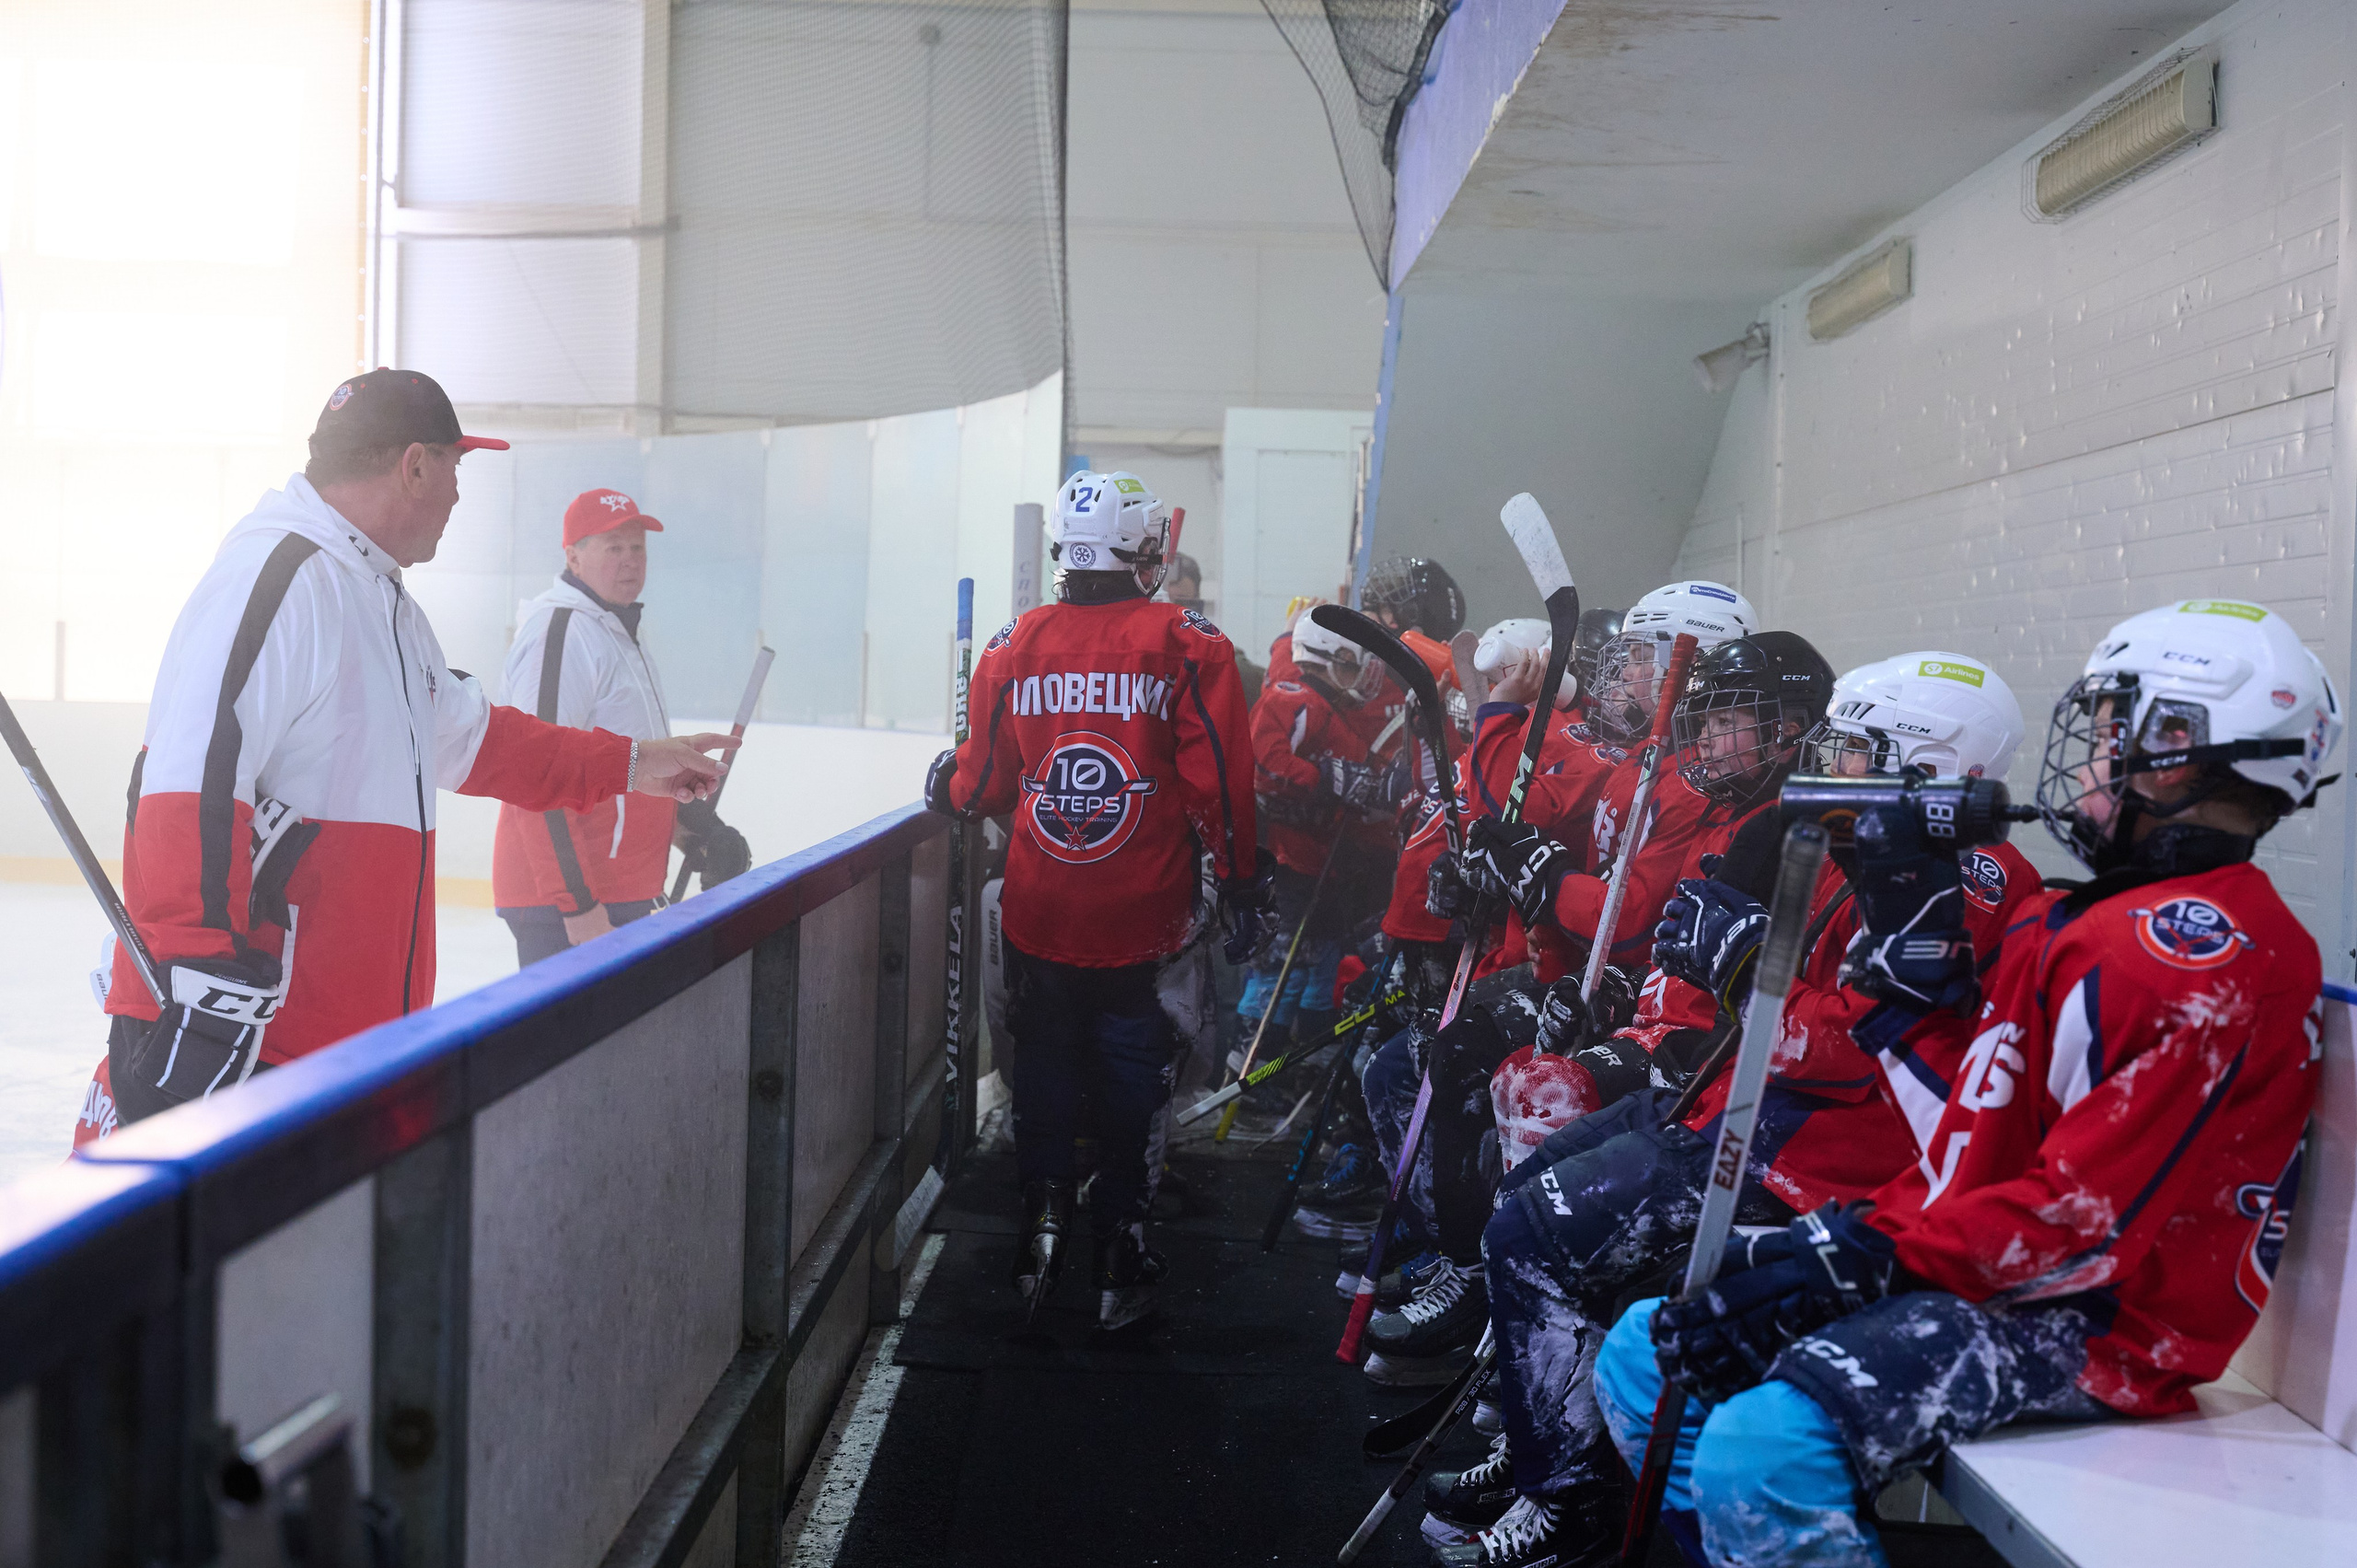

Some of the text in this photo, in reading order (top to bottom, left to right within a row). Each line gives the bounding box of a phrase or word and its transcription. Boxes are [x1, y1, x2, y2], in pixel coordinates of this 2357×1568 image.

[1075, 487, 1093, 512] 2
[1686, 619, 1725, 633] BAUER
[2163, 651, 2211, 666] CCM
[1945, 667, 1980, 681] Airlines
[1014, 672, 1177, 722] ЛОВЕЦКИЙ
[1896, 722, 1932, 735] CCM
[1057, 758, 1107, 791] 10
[1039, 794, 1120, 814] STEPS
[1058, 815, 1084, 823] HOCKEY
[1972, 854, 2000, 880] 10
[1961, 865, 2003, 897] STEPS
[2176, 900, 2220, 926] 10
[988, 909, 999, 966] BAUER
[2155, 917, 2225, 946] STEPS
[215, 972, 248, 985] PENGUINS
[946, 905, 963, 1083] VIKKELA
[1713, 1128, 1746, 1191] EAZY
[1540, 1167, 1573, 1216] CM
[1792, 1336, 1879, 1388] CM
[1475, 1369, 1492, 1388] FLEX
